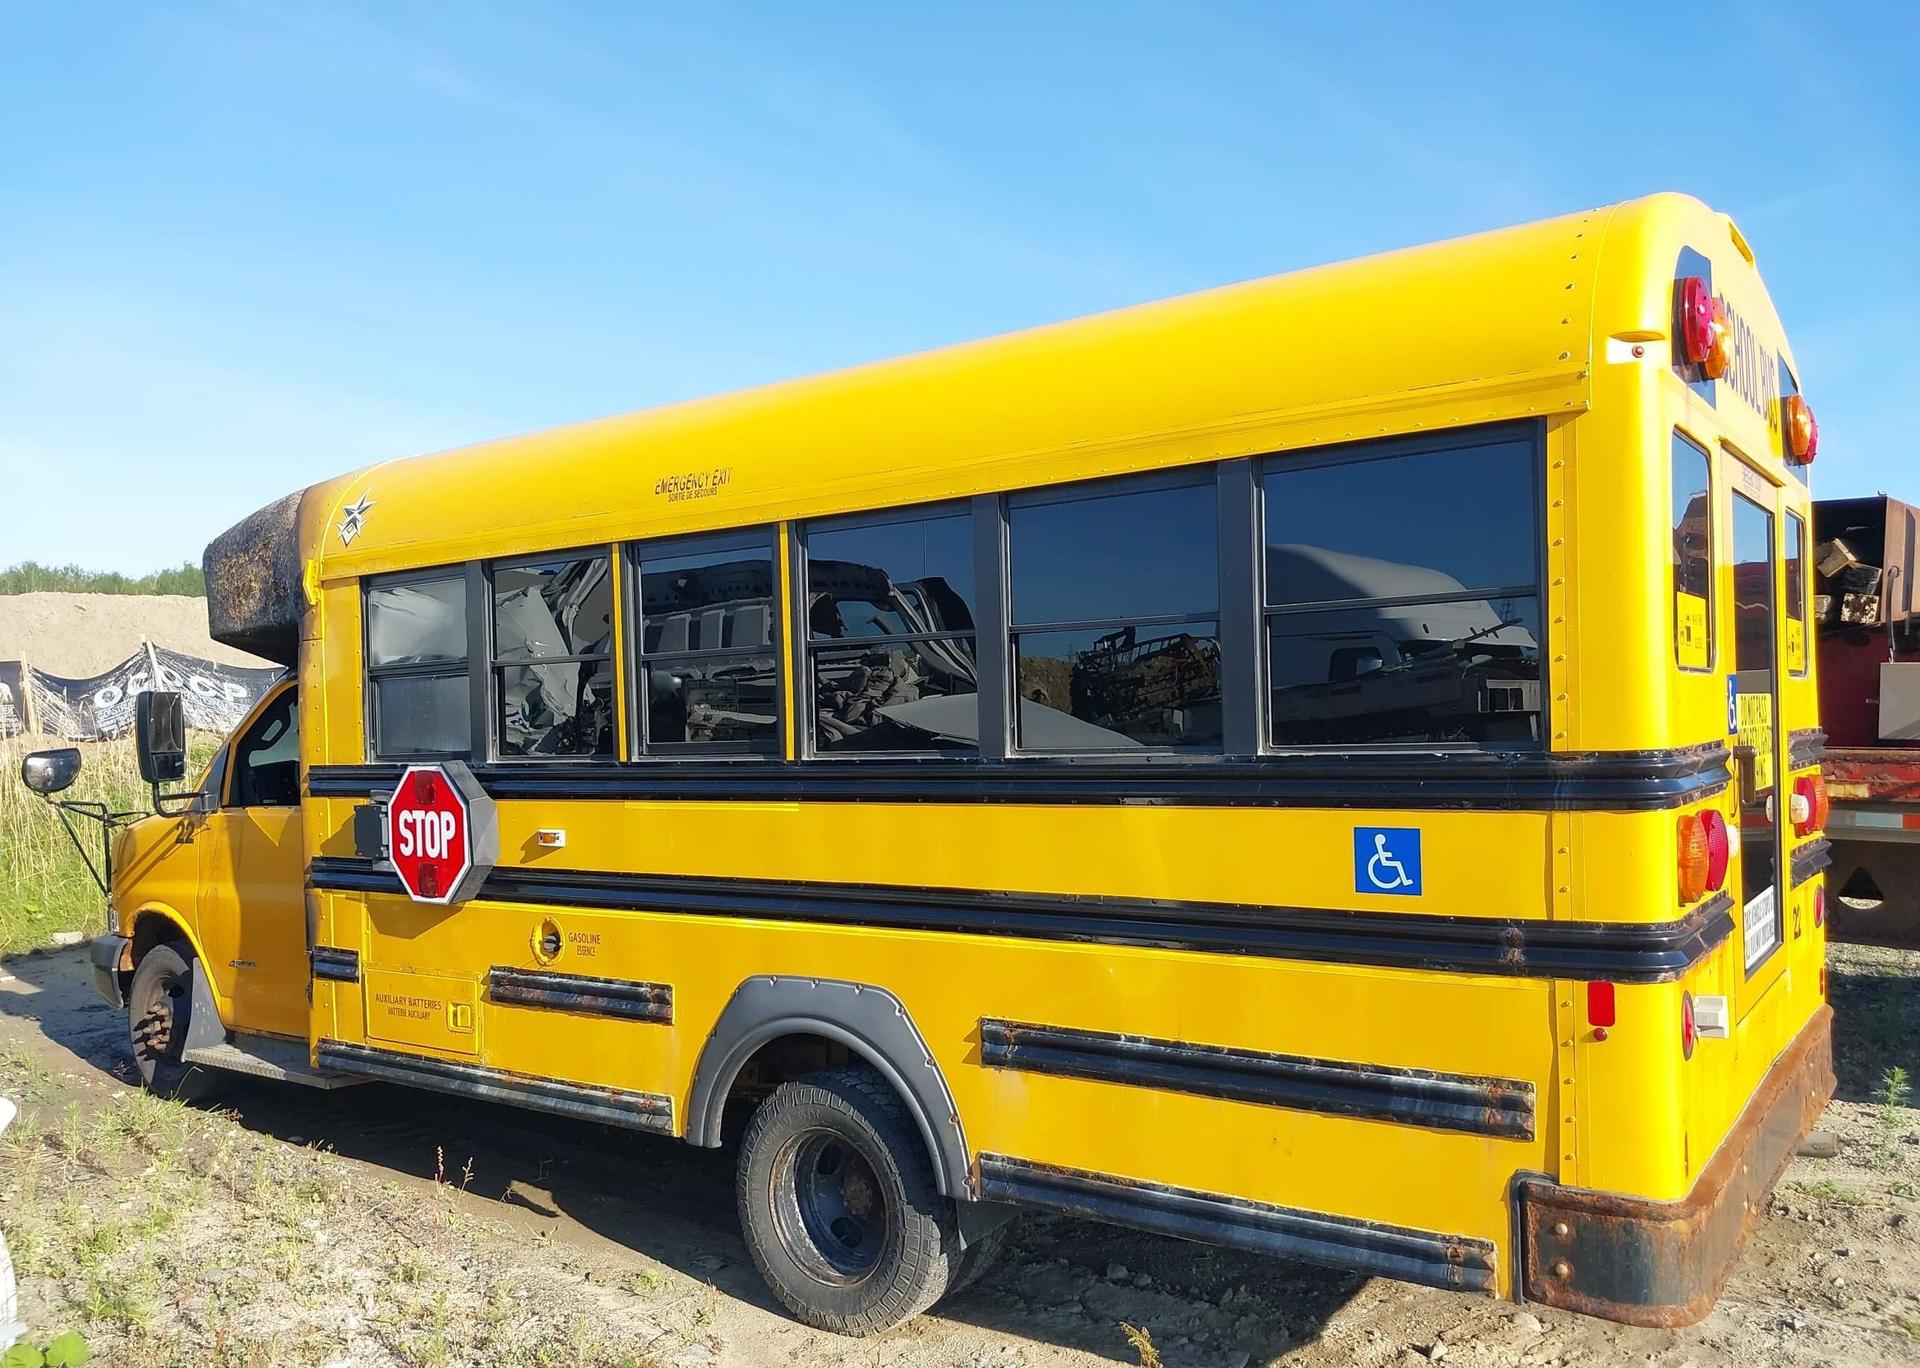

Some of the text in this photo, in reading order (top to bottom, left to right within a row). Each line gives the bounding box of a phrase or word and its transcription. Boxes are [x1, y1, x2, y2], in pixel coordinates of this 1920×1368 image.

[1760, 344, 1777, 433] BUS
[655, 467, 733, 495] EMERGENCY EXIT
[668, 487, 718, 502] SORTIE DE SECOURS
[175, 820, 194, 844] 22
[399, 810, 456, 859] STOP
[1793, 904, 1801, 940] 22
[569, 932, 600, 945] GASOLINE
[577, 945, 596, 957] ESSENCE
[375, 993, 442, 1011] AUXILIARY BATTERIES
[387, 1006, 407, 1017] BATTERIE
